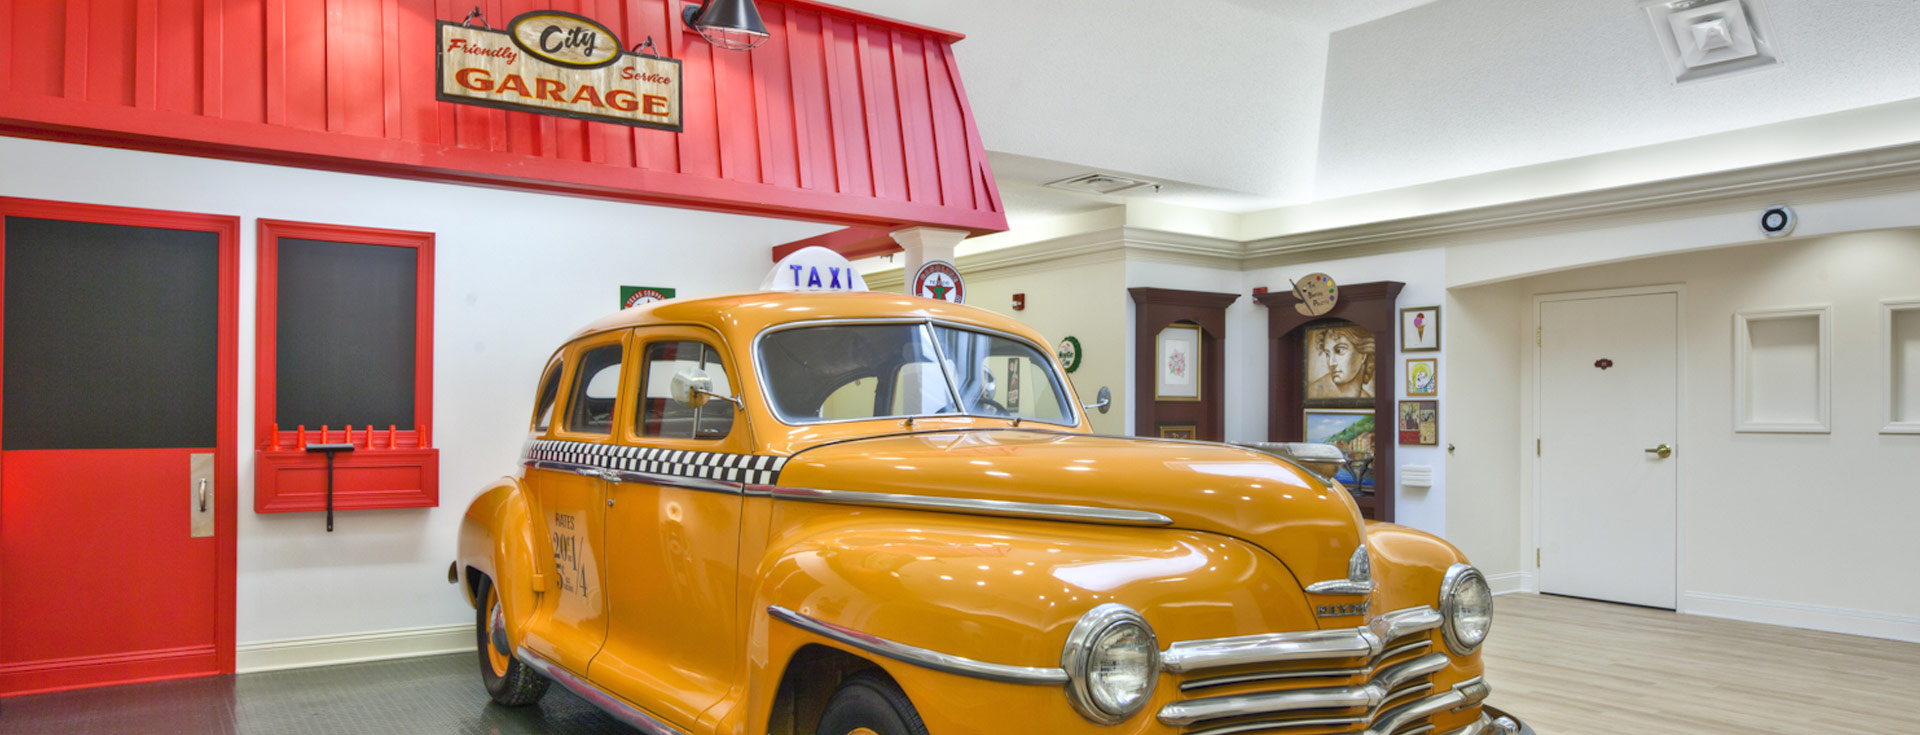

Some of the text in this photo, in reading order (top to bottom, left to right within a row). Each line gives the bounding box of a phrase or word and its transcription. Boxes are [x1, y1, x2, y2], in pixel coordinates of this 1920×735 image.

[447, 38, 518, 65] Friendly
[539, 25, 598, 57] City
[620, 66, 672, 85] Service
[455, 67, 670, 117] GARAGE
[789, 264, 853, 290] TAXI
[555, 512, 575, 531] RATES
